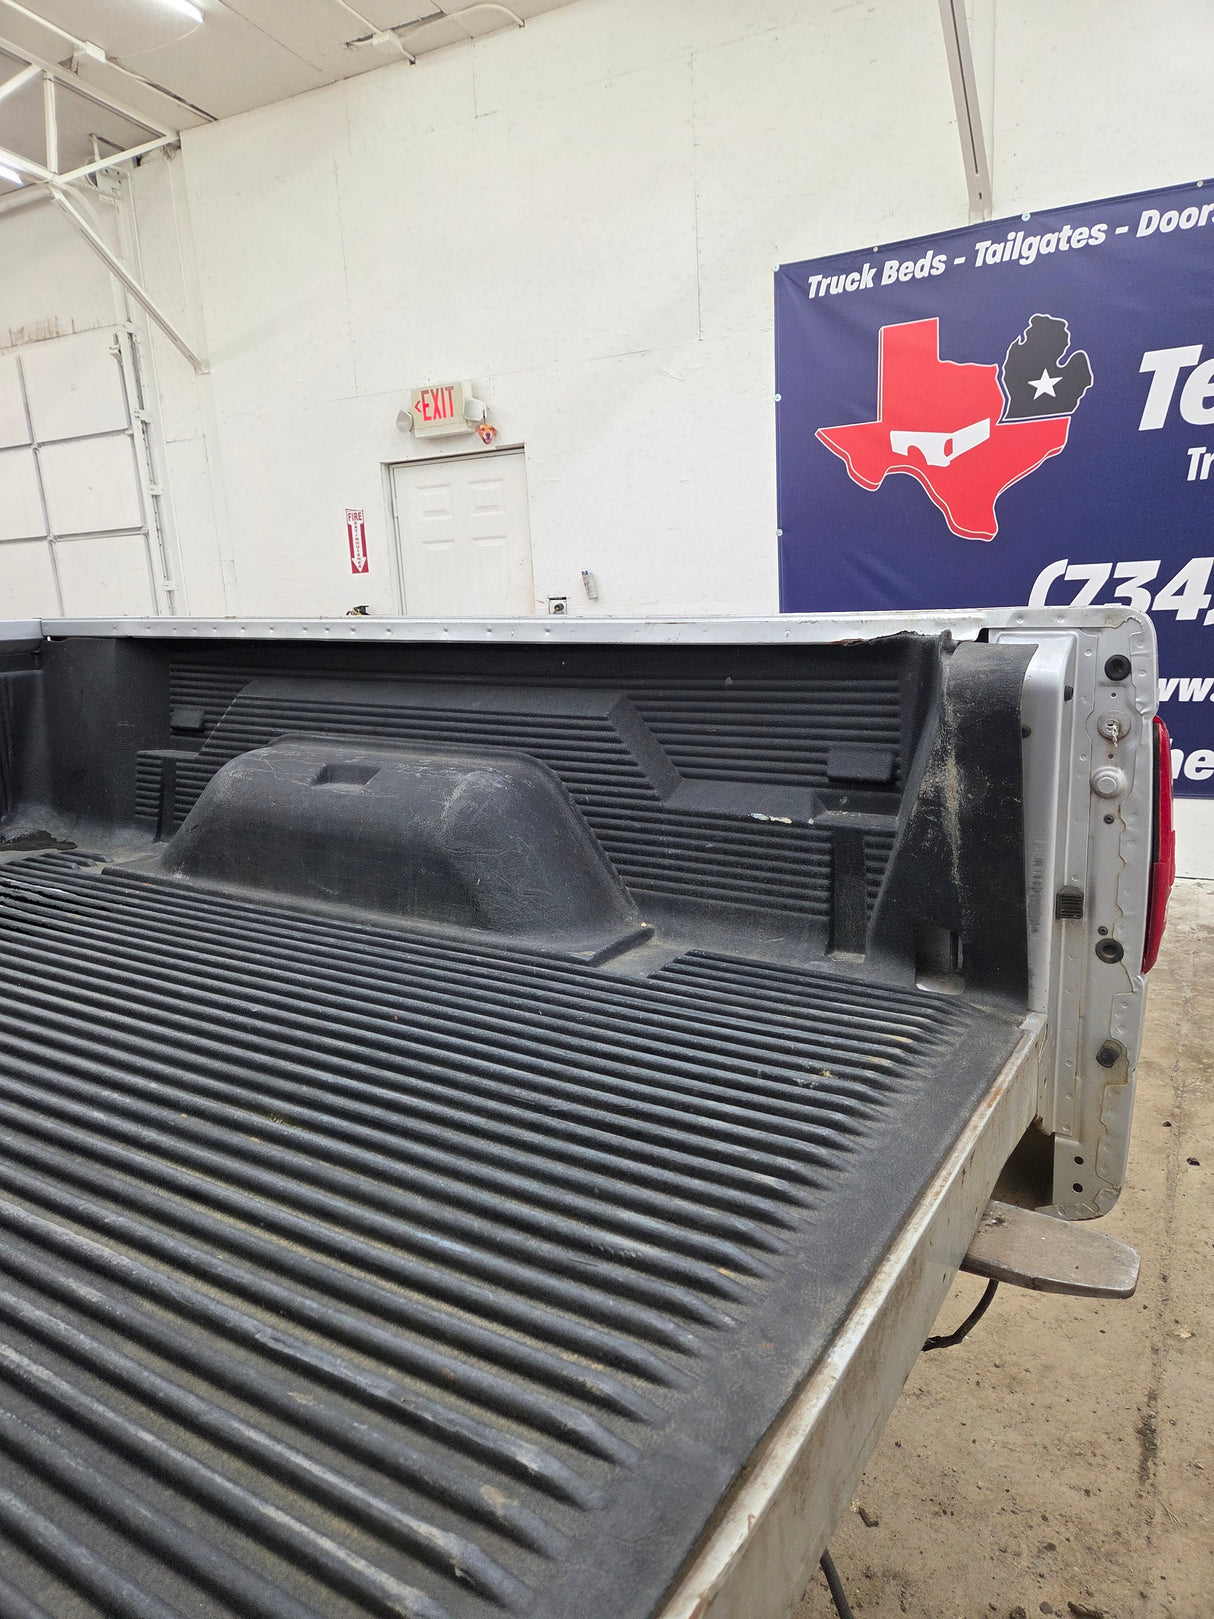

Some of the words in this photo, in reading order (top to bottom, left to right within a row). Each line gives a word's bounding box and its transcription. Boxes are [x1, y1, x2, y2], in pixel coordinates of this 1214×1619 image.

[808, 263, 877, 299] Truck
[880, 249, 947, 286] Beds
[953, 256, 966, 264] -
[975, 223, 1108, 267] Tailgates
[1115, 226, 1129, 234] -
[1136, 203, 1214, 238] Door
[421, 385, 454, 421] EXIT
[1138, 344, 1214, 431] Te
[1187, 447, 1214, 481] Tr
[348, 512, 363, 521] FIRE
[1028, 558, 1214, 626] (734
